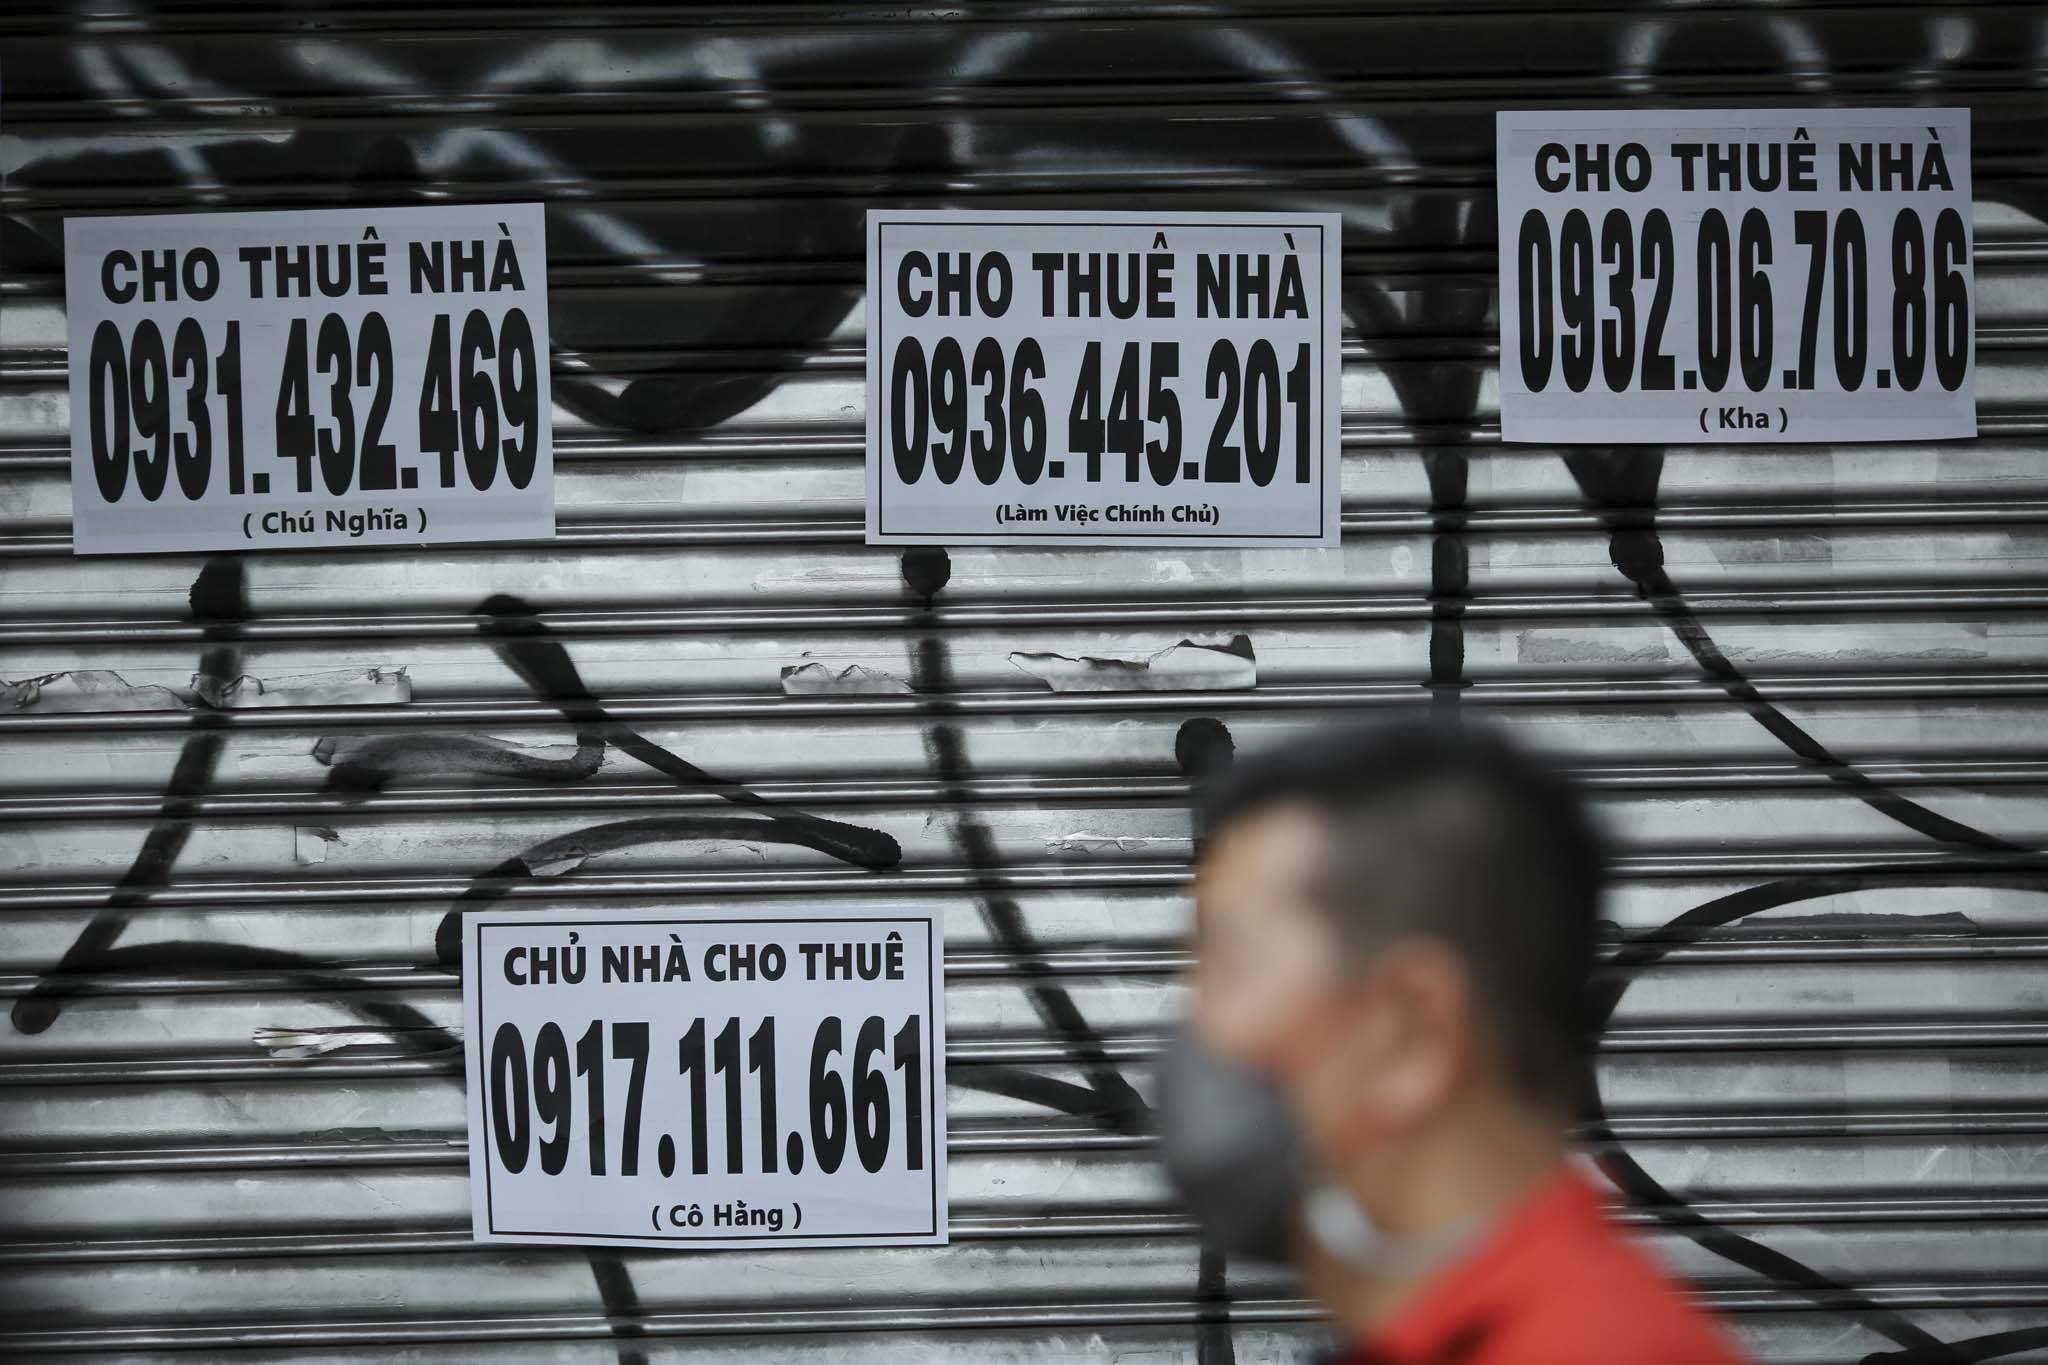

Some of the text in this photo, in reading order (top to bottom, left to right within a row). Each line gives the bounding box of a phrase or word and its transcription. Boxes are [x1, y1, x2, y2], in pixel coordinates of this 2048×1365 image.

[1535, 126, 1954, 193] CHO THUÊ NHÀ
[101, 222, 526, 304] CHO THUÊ NHÀ
[897, 231, 1309, 320] CHO THUÊ NHÀ
[1518, 208, 1969, 393] 0932.06.70.86
[89, 307, 539, 504] 0931.432.469
[890, 336, 1312, 488] 0936.445.201
[995, 503, 1220, 526] (Làm Việc Chính Chủ)
[503, 930, 905, 986] CHỦ NHÀ CHO THUÊ
[490, 1014, 924, 1178] 0917.111.661
